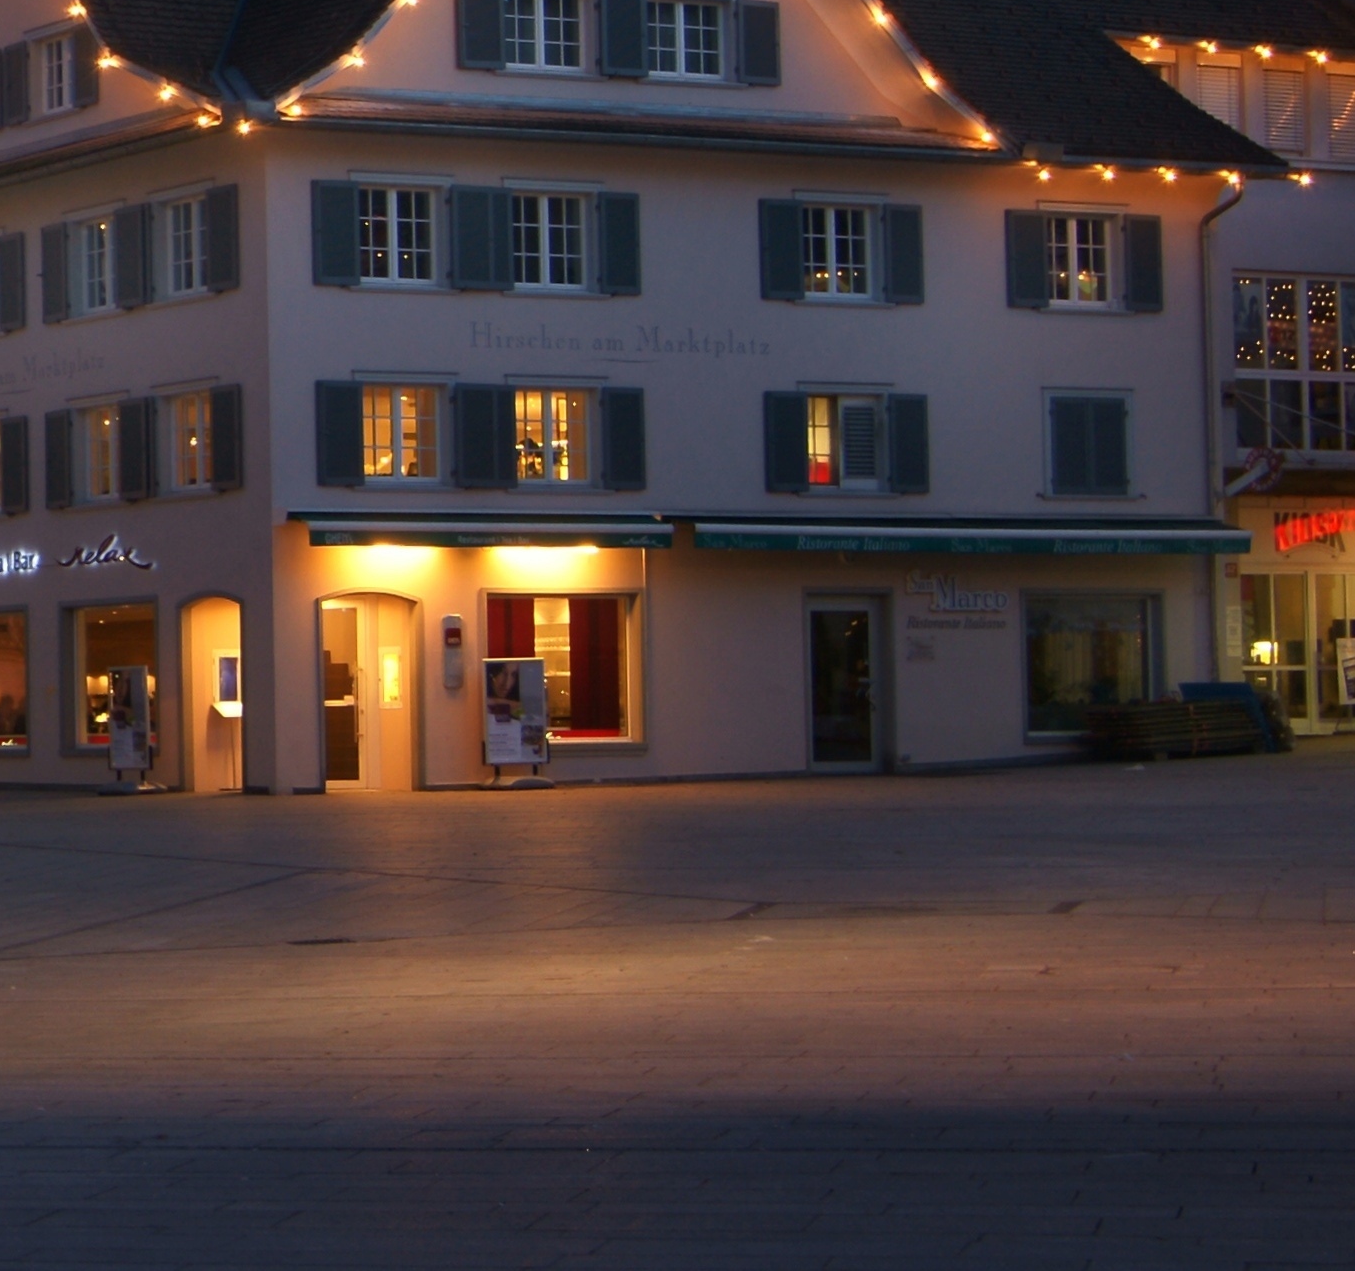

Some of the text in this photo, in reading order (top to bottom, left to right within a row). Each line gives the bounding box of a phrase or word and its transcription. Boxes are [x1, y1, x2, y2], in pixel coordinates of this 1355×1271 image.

[468, 320, 770, 358] Hirschen am Marktplatz
[702, 536, 726, 548] San
[730, 536, 768, 549] Marco
[796, 536, 858, 551] Ristorante
[863, 536, 911, 551] Italiano
[950, 538, 973, 552] San
[976, 539, 1013, 553] Marco
[1053, 539, 1115, 553] Ristorante
[1117, 539, 1162, 553] Italiano
[1274, 511, 1346, 553] KIOSK
[13, 551, 35, 572] Bar
[55, 533, 153, 571] relax
[907, 570, 935, 590] San
[935, 575, 1008, 609] Marco
[907, 616, 1006, 630] Ristorante Italiano
